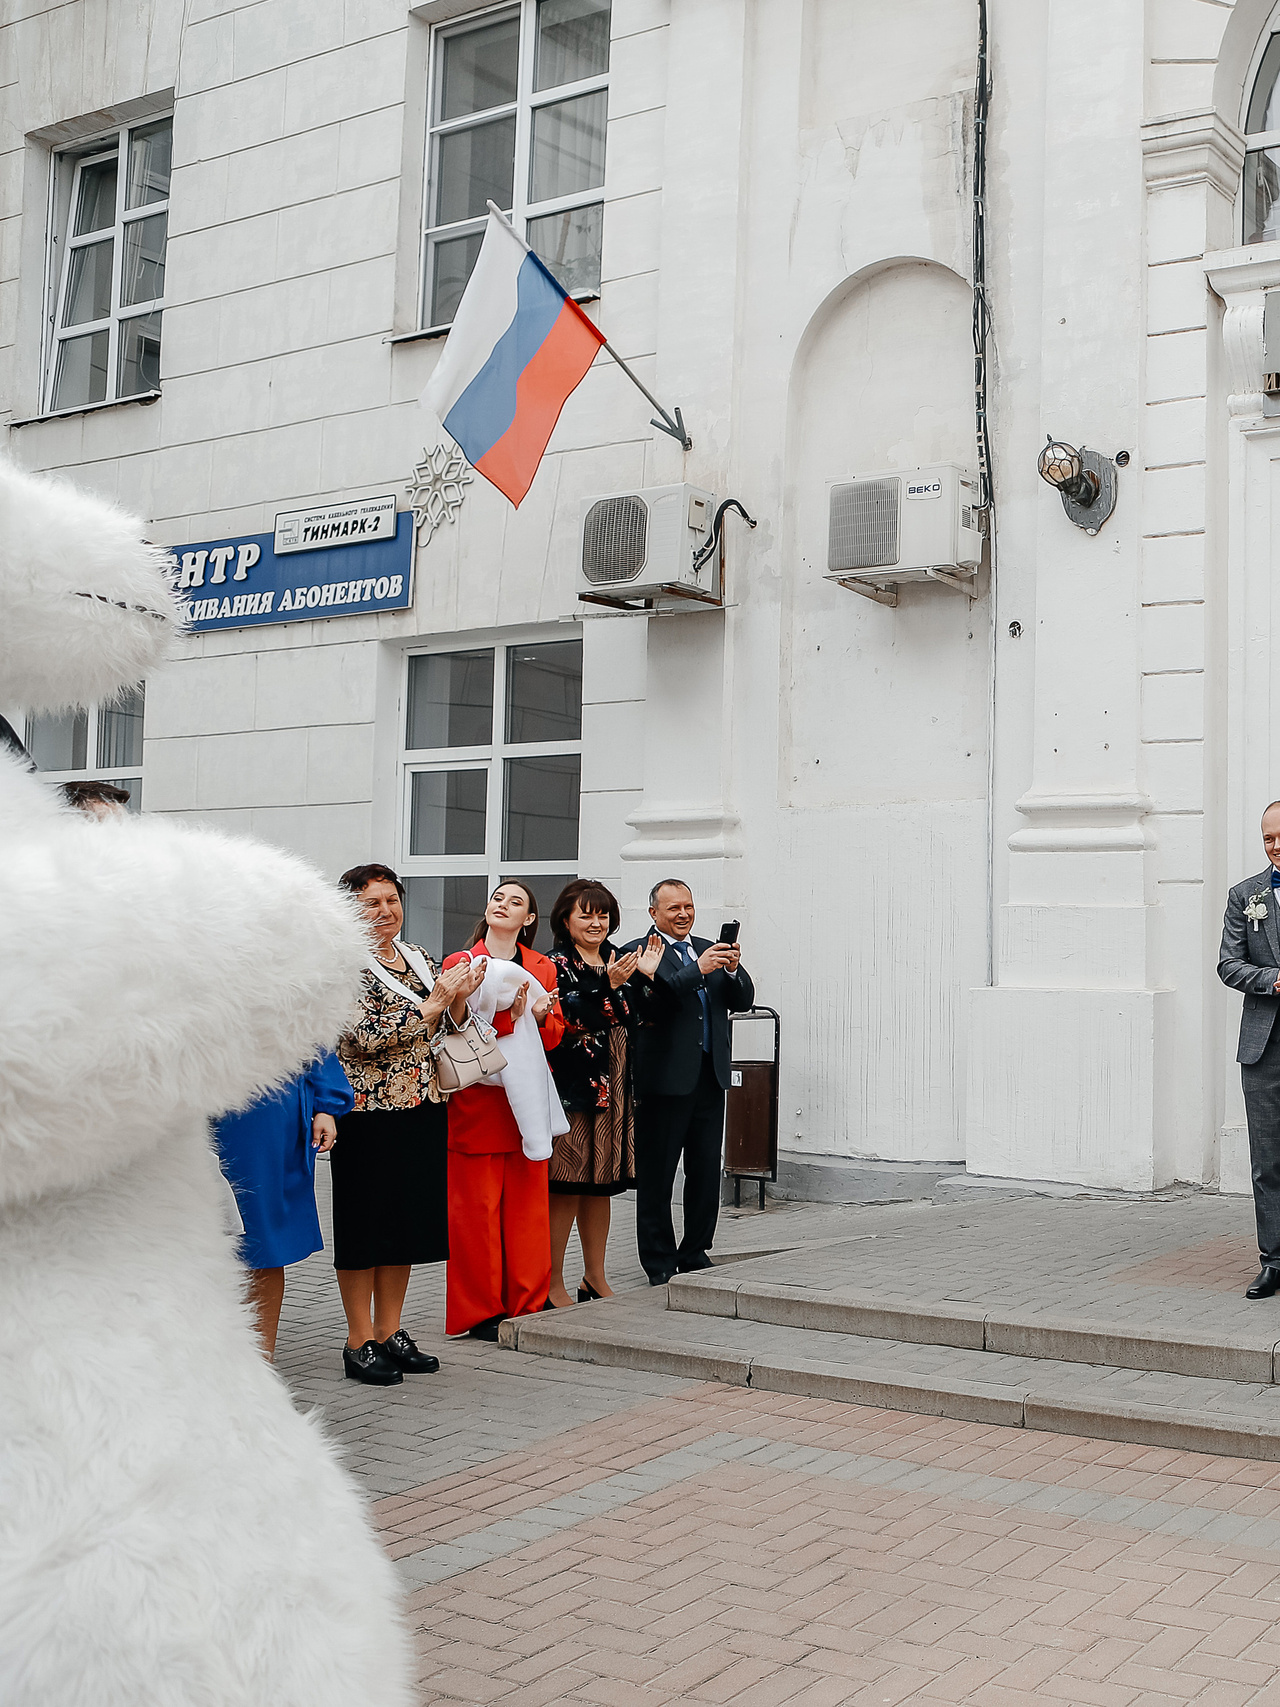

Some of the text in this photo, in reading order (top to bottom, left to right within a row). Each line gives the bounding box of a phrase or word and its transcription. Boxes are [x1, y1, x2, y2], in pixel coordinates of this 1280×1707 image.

[908, 483, 940, 494] BEKO
[303, 515, 381, 542] ТИНМАРК-2
[172, 543, 261, 588] НТР
[277, 574, 404, 612] АБОНЕНТОВ
